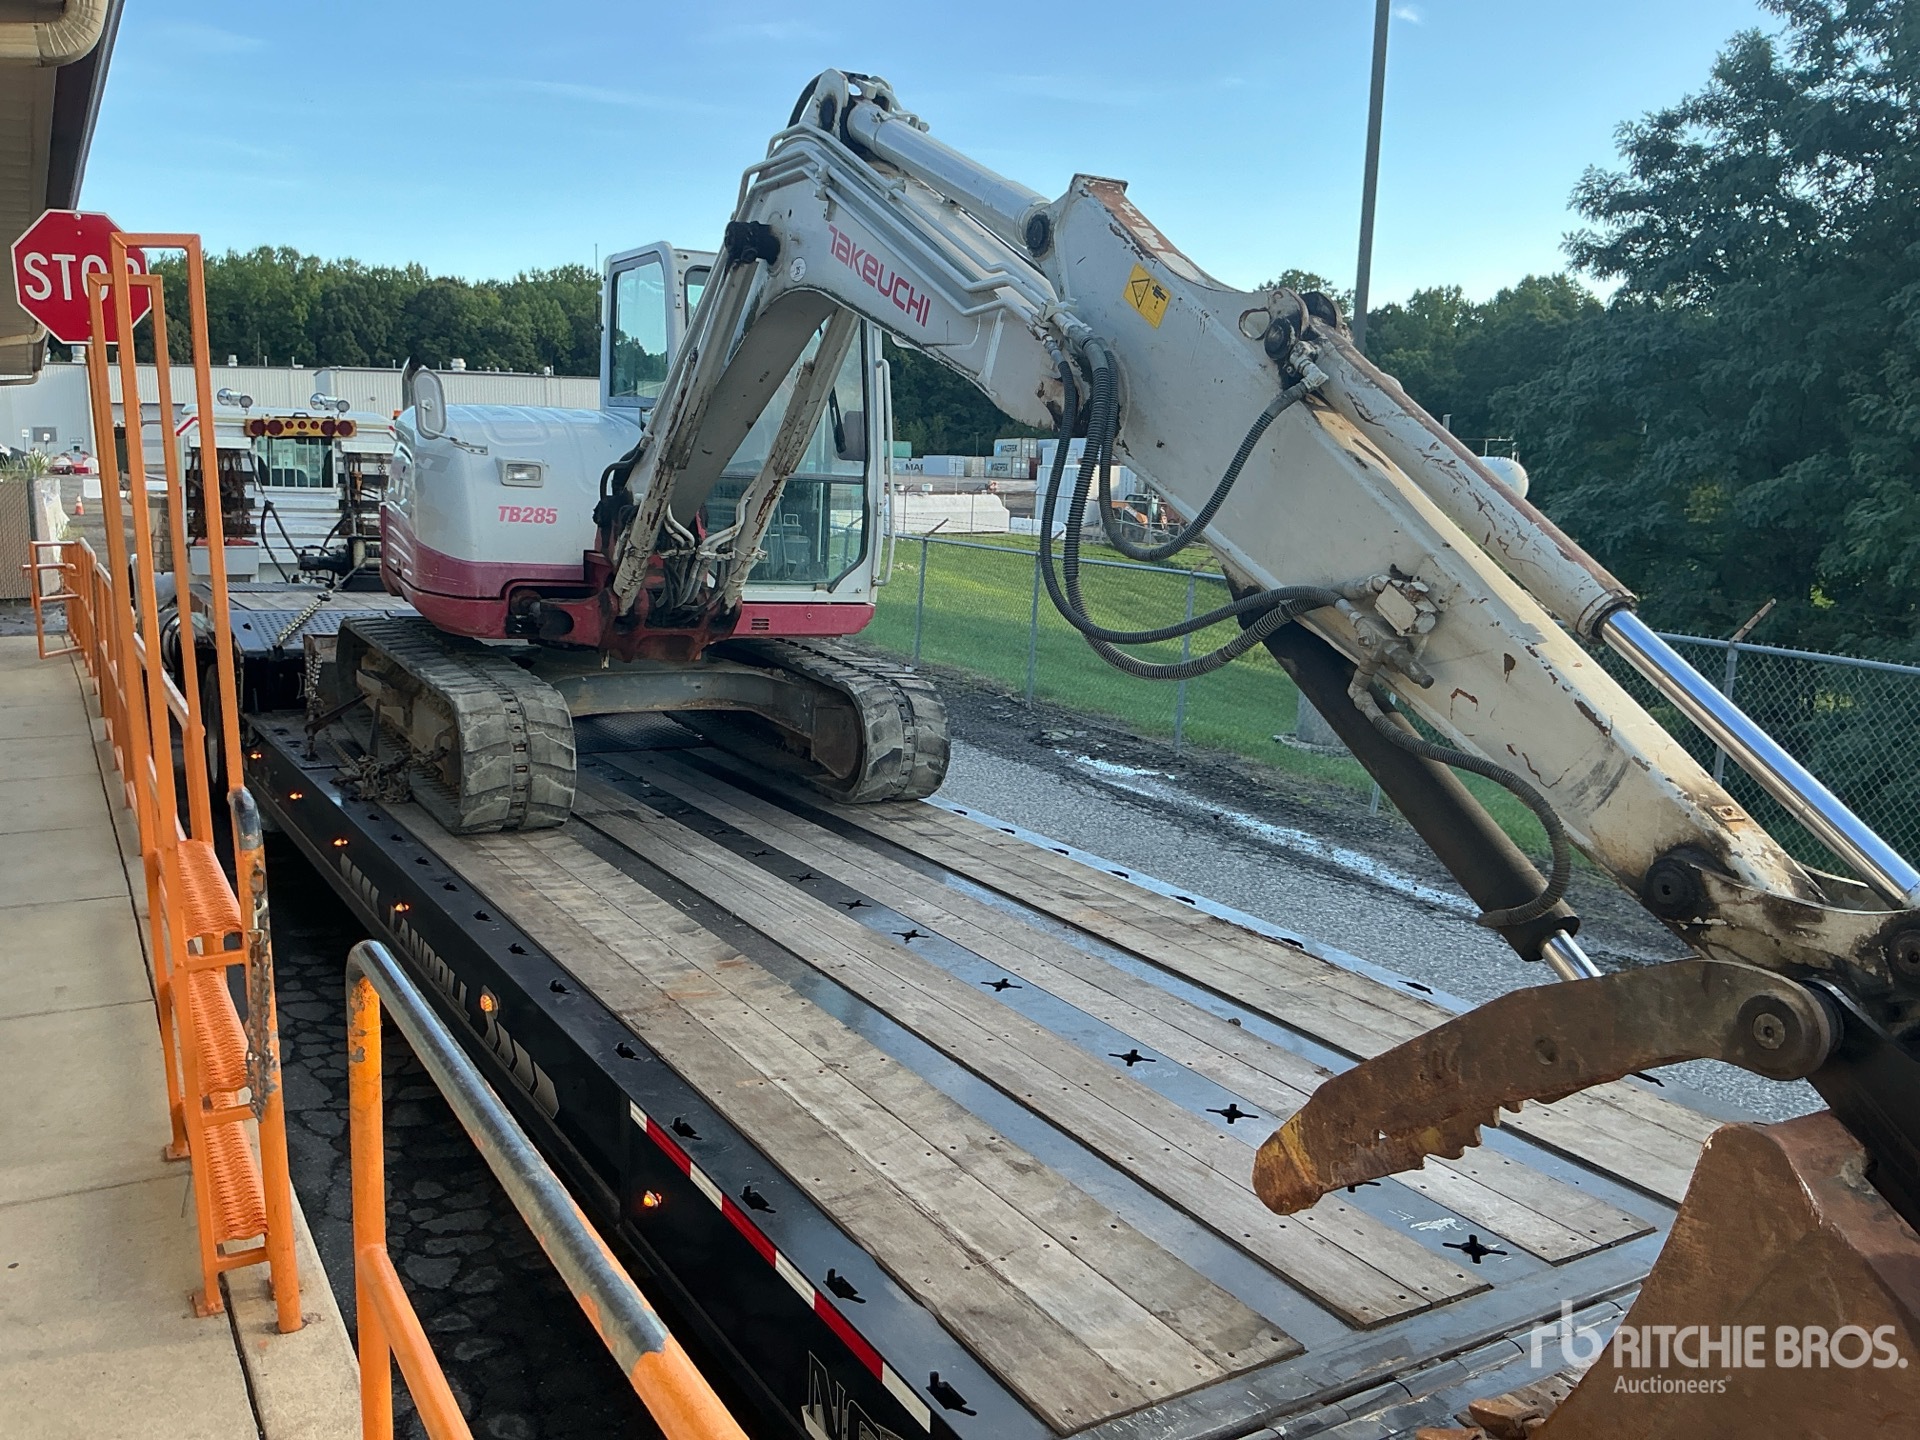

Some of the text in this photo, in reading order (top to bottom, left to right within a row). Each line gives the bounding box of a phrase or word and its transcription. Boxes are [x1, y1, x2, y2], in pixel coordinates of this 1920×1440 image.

[24, 252, 140, 301] STO
[498, 505, 558, 525] TB285
[388, 904, 471, 1022] LANDOLL
